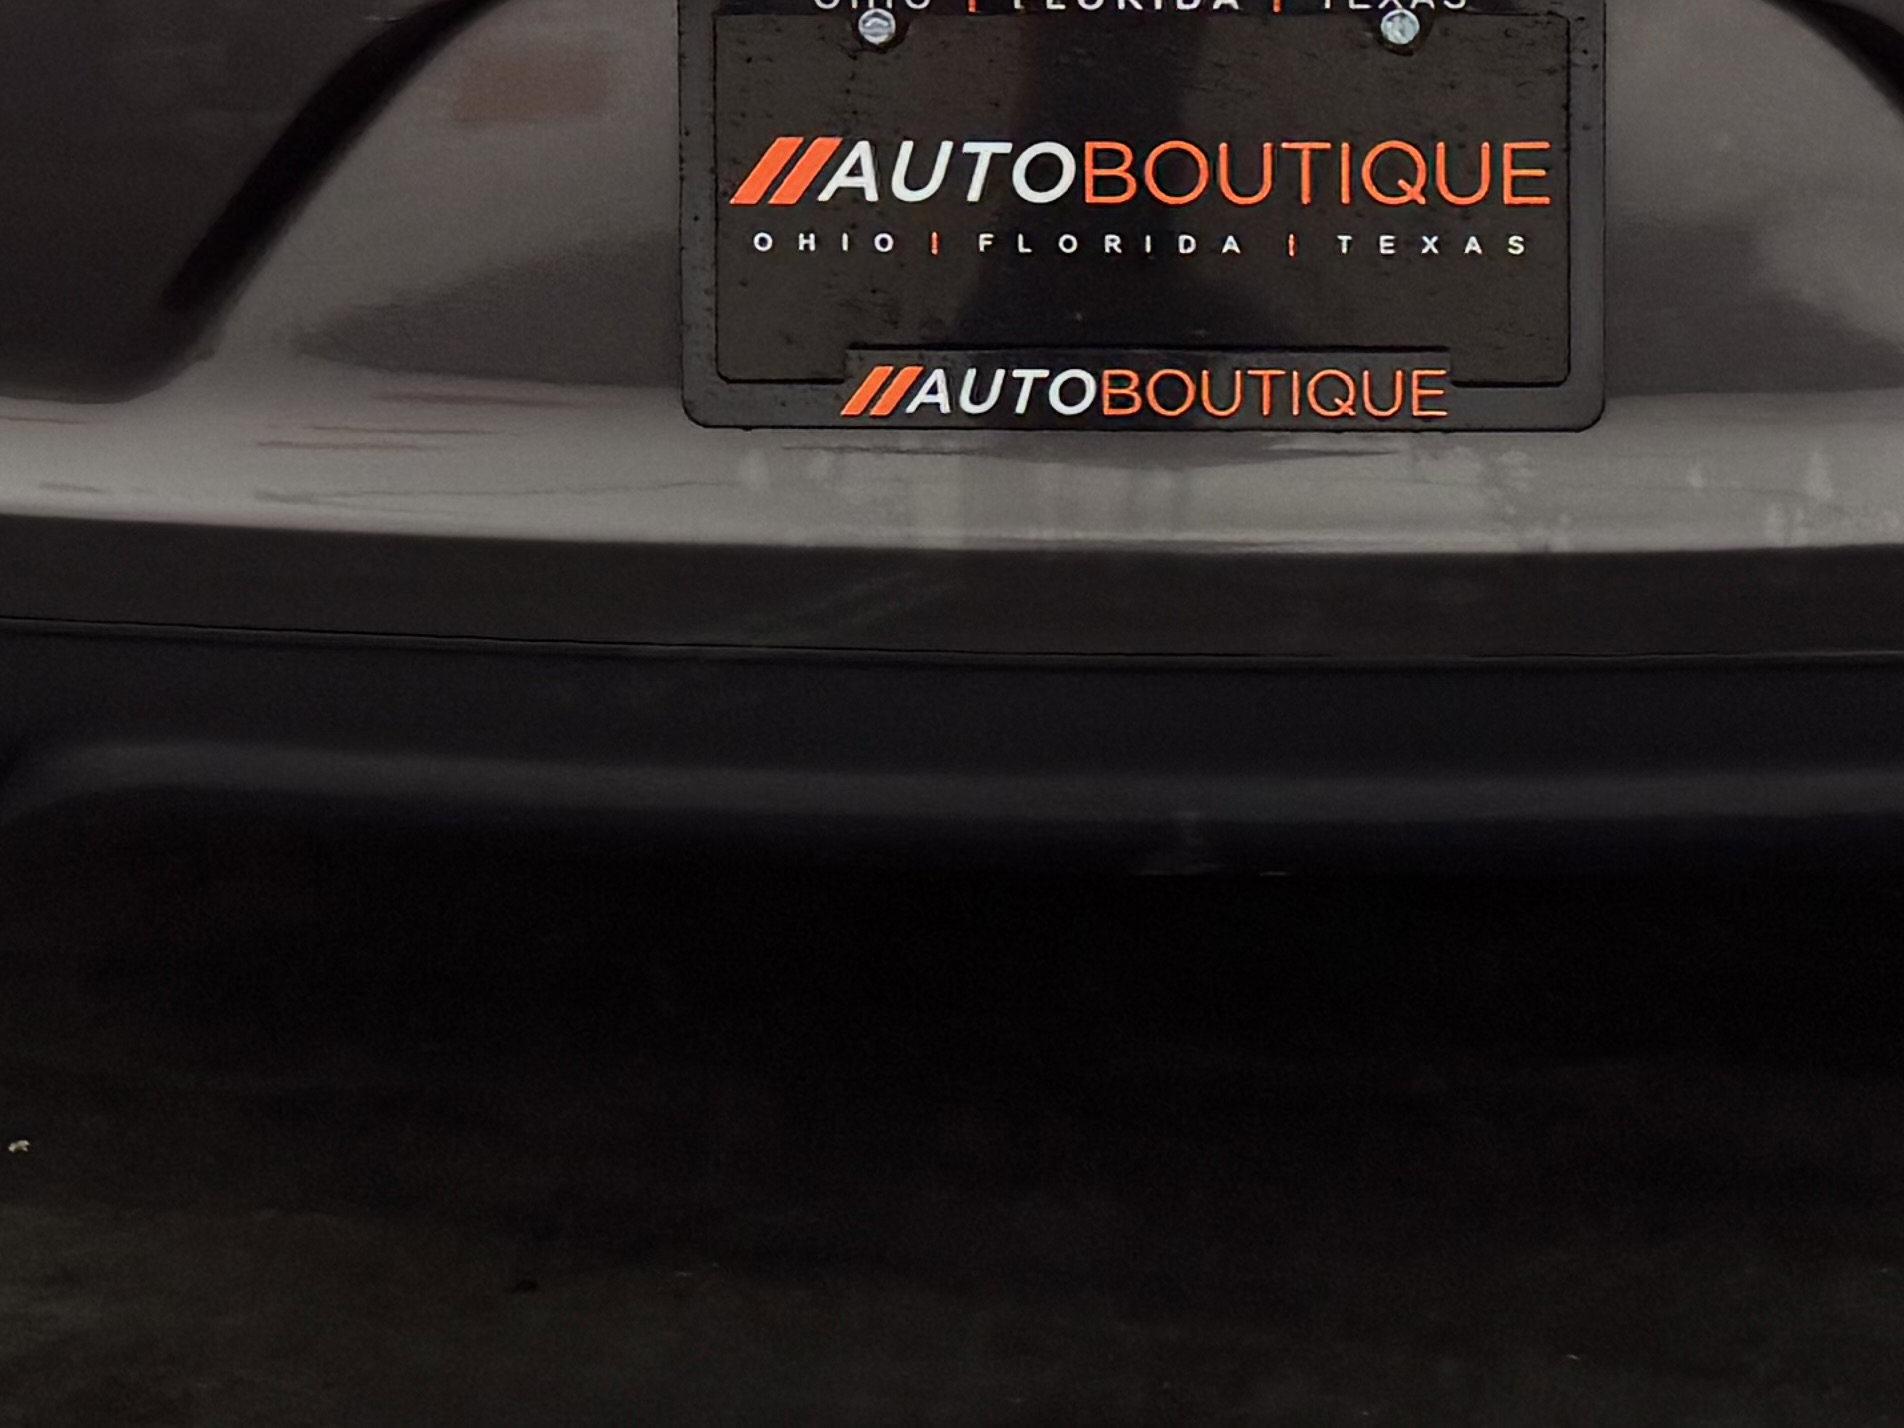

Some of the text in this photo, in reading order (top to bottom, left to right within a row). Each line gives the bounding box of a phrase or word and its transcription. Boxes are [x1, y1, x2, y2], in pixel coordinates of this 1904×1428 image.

[818, 140, 1551, 206] AUTOBOUTIQUE
[753, 232, 1527, 256] OHIO FLORIDA TEXAS
[906, 367, 1448, 417] AUTOBOUTIQUE
